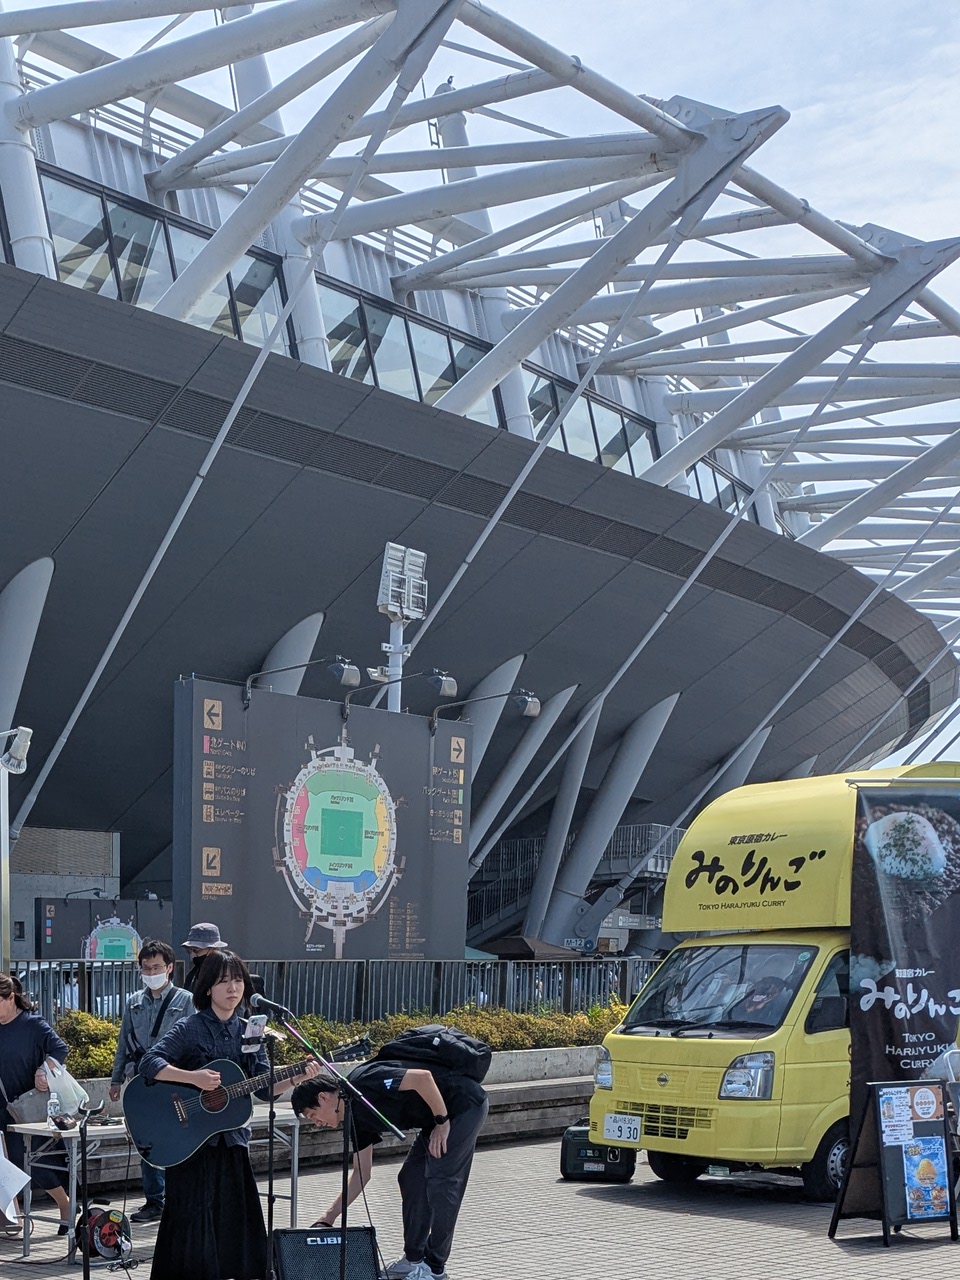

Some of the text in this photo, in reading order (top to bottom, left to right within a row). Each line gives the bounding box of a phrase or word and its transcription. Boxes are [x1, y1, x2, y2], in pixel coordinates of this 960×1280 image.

[728, 832, 788, 846] 東京原宿カレー
[685, 850, 826, 895] みのりんご
